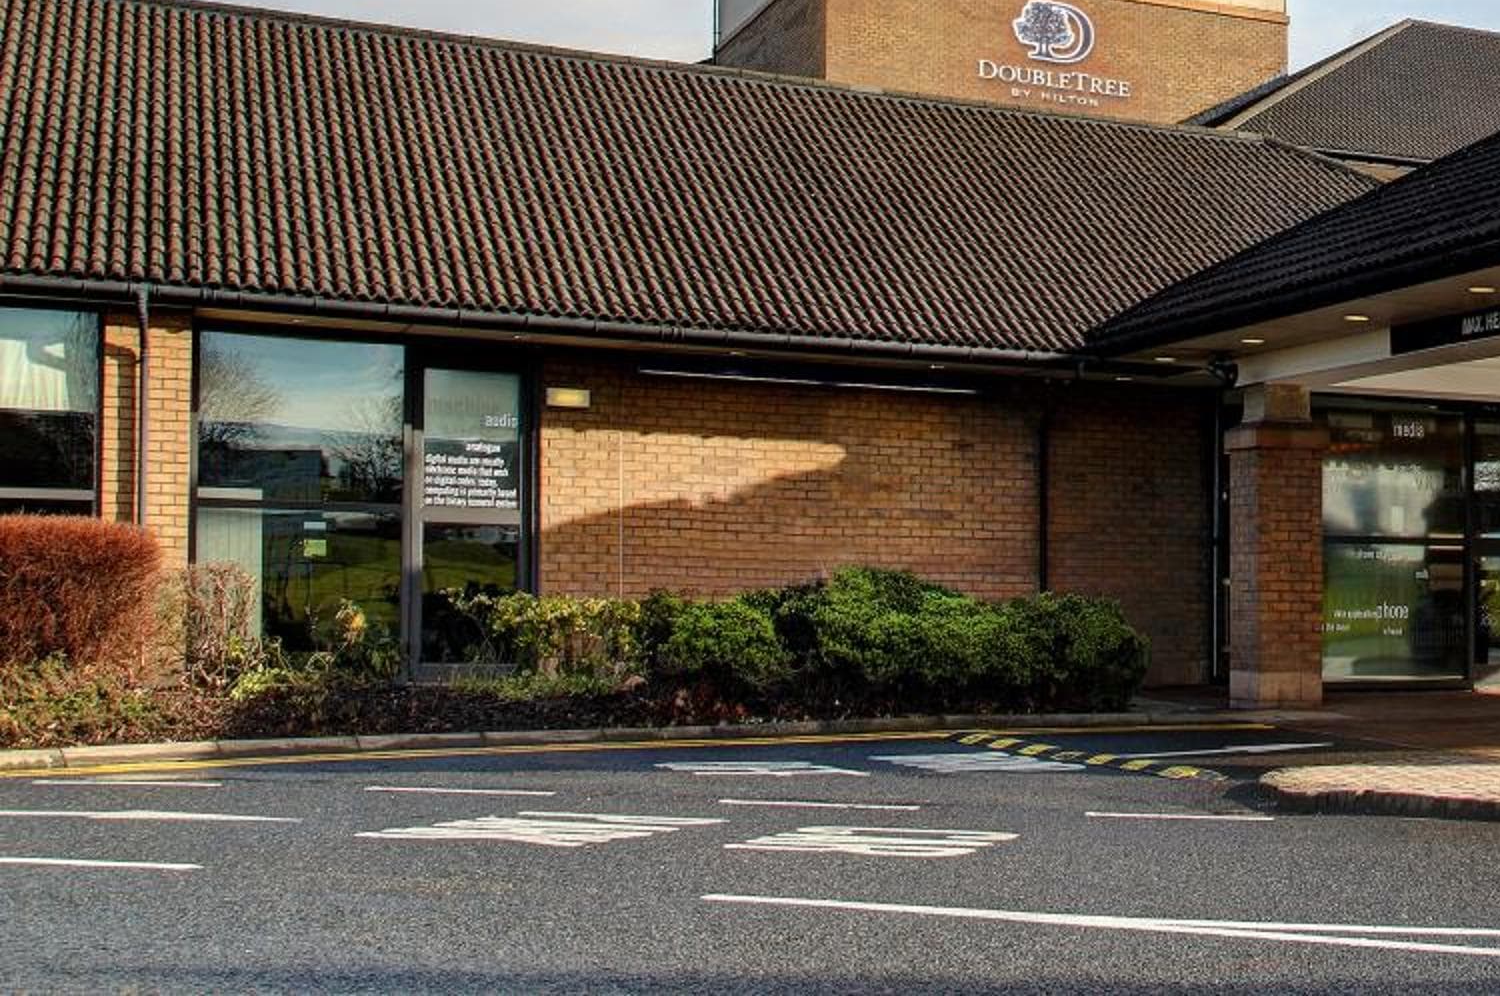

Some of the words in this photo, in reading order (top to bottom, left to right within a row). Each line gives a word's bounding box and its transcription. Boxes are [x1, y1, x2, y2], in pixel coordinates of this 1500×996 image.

[978, 59, 1131, 97] DOUBLETREE
[1011, 87, 1031, 98] BY
[1041, 91, 1099, 107] HILTON
